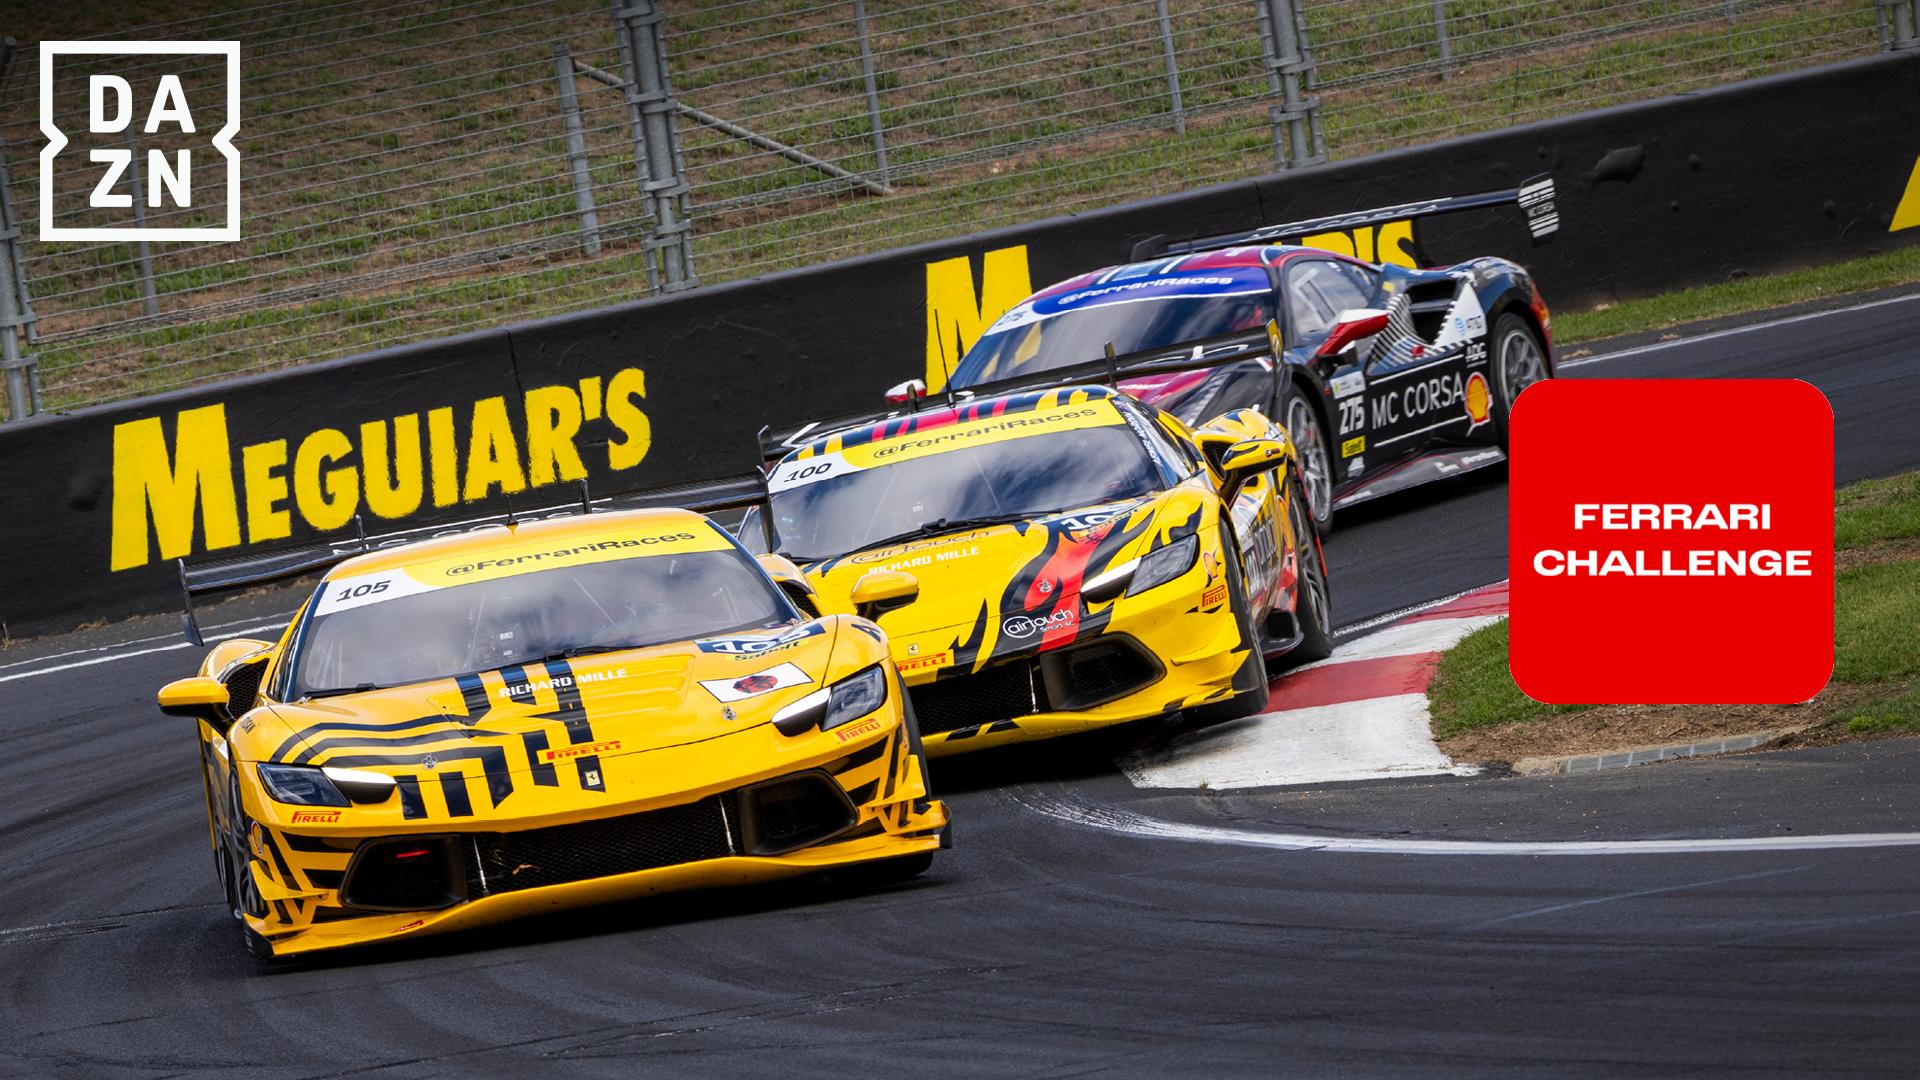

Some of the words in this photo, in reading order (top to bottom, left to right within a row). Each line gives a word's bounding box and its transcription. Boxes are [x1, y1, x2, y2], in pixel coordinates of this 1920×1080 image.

[1058, 277, 1233, 305] @FerrariRaces
[1339, 395, 1365, 435] 275
[1372, 391, 1399, 430] MC
[1403, 371, 1466, 419] CORSA
[873, 408, 1097, 460] @FerrariRaces
[784, 463, 832, 482] 100
[446, 532, 696, 577] @FerrariRaces
[868, 554, 932, 575] RICHARD
[936, 546, 980, 562] MILLE
[336, 580, 391, 602] 105
[1202, 585, 1227, 607] PIRELLI
[1004, 609, 1074, 636] airtouch
[500, 677, 572, 698] RICHARD
[578, 669, 627, 683] MILLE
[835, 718, 880, 742] PIRELLI
[291, 811, 342, 823] PIRELLI
